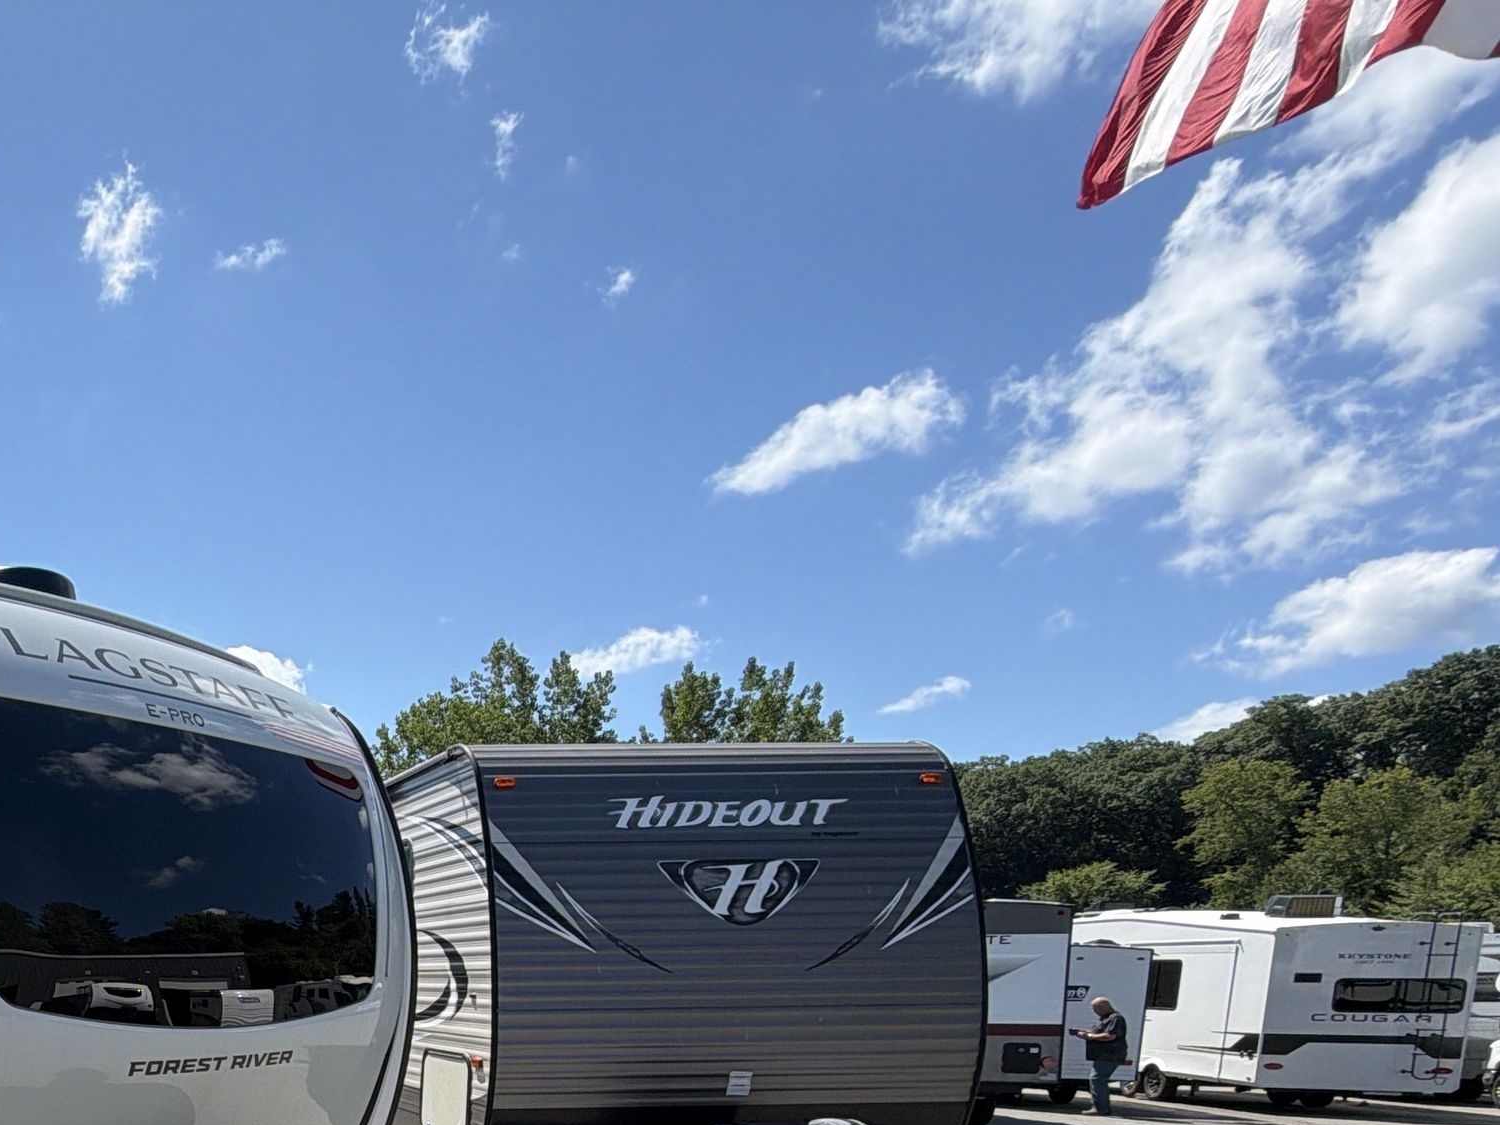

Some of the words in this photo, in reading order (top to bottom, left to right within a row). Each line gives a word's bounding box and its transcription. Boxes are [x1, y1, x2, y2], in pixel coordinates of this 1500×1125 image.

[145, 703, 206, 728] E-PRO
[607, 795, 849, 829] HIDEOUT
[1311, 1013, 1432, 1024] COUGAR
[128, 1056, 228, 1077] FOREST
[230, 1050, 294, 1070] RIVER
